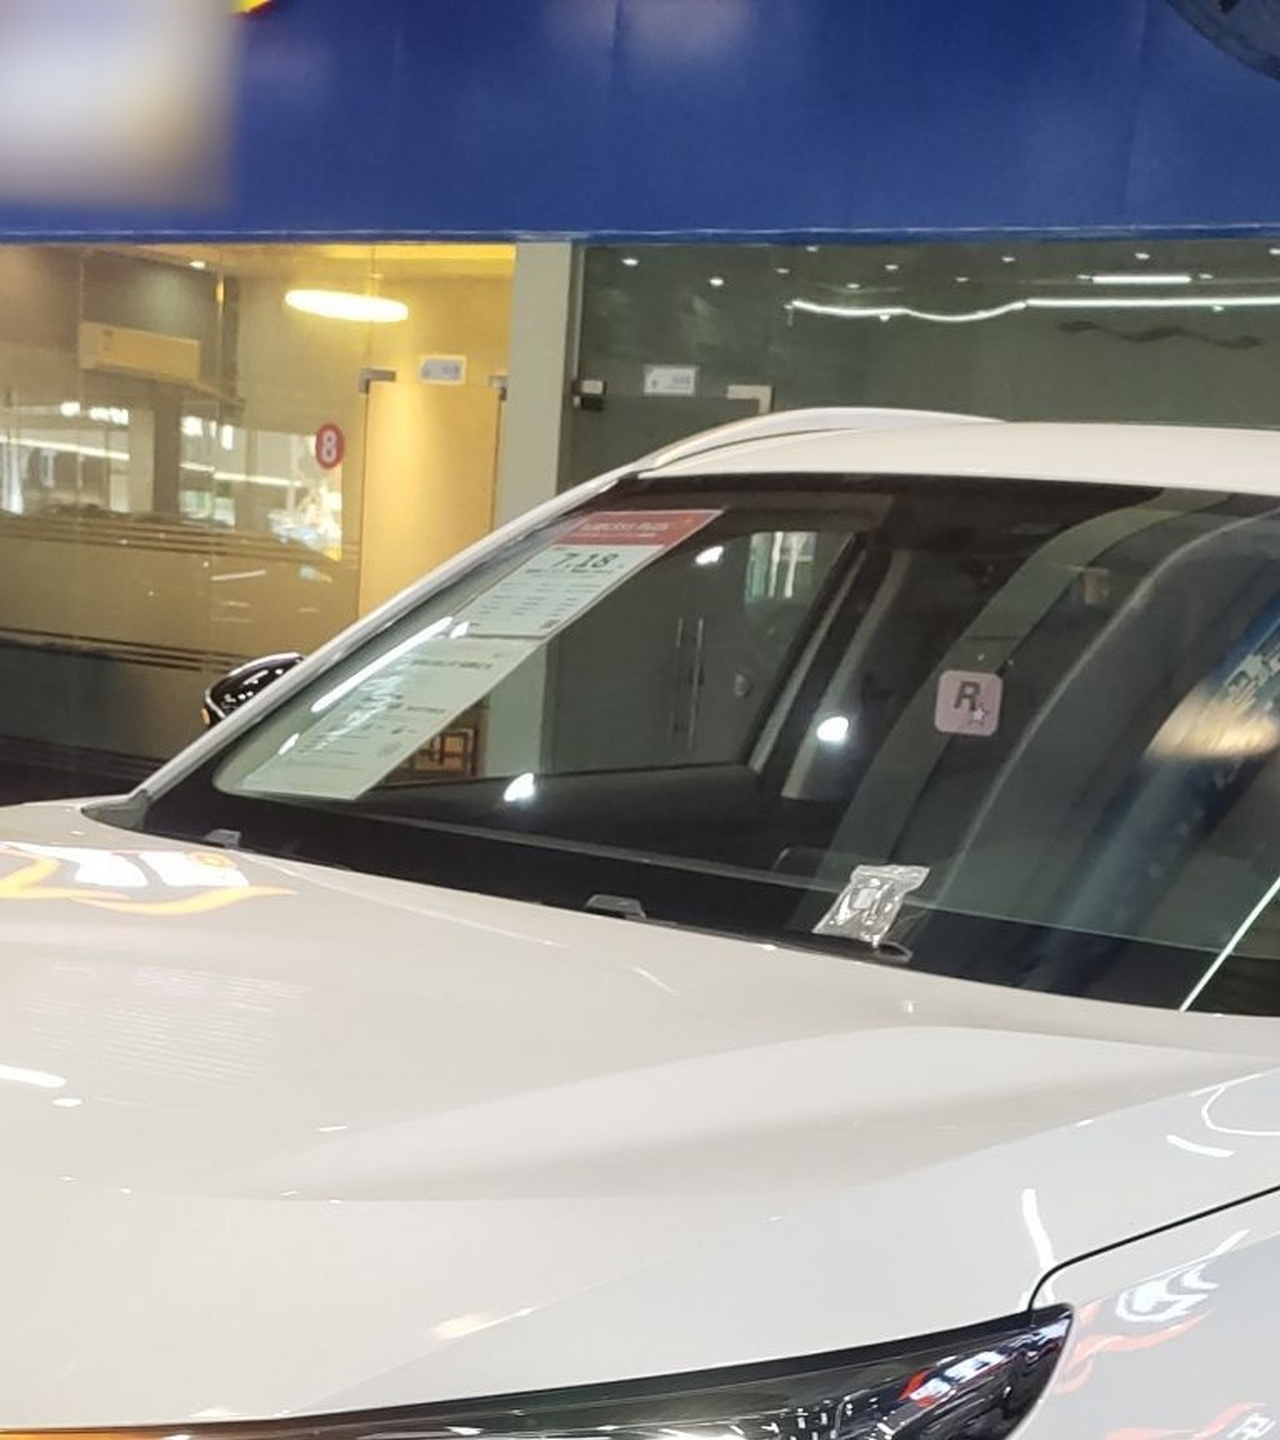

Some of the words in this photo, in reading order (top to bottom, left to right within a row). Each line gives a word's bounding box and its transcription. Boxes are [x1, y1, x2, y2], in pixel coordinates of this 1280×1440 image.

[322, 429, 338, 462] 8
[552, 552, 619, 568] 7.18
[953, 681, 981, 711] R
